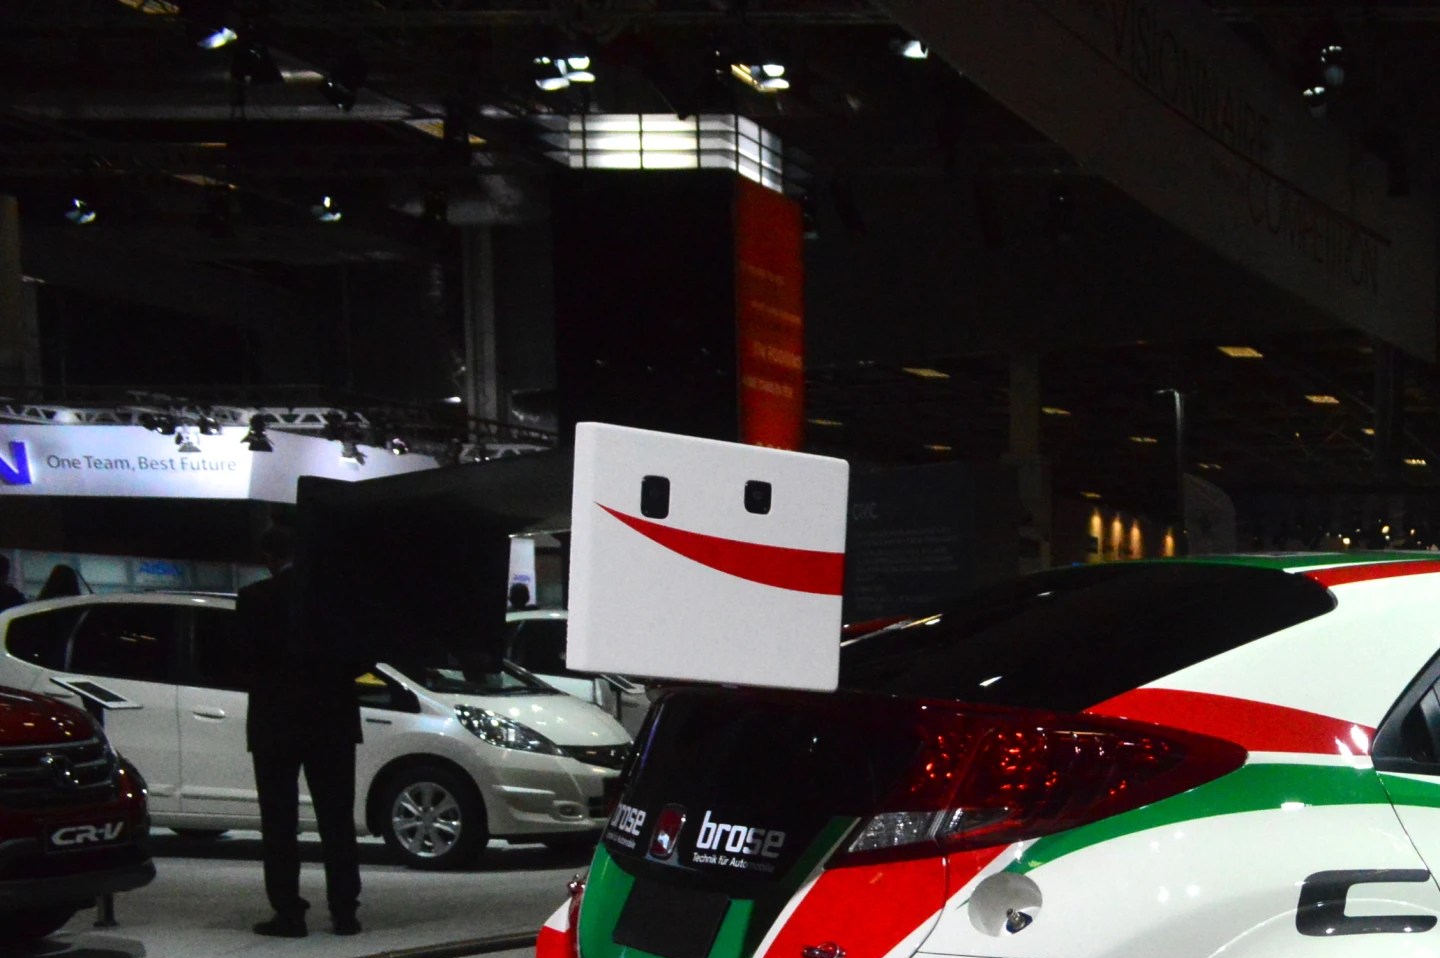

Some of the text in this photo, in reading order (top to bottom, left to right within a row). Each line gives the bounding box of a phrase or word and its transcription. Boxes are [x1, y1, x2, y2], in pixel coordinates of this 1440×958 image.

[47, 454, 237, 472] One Team, Best Future
[51, 821, 125, 846] CR-V
[696, 810, 786, 859] brose
